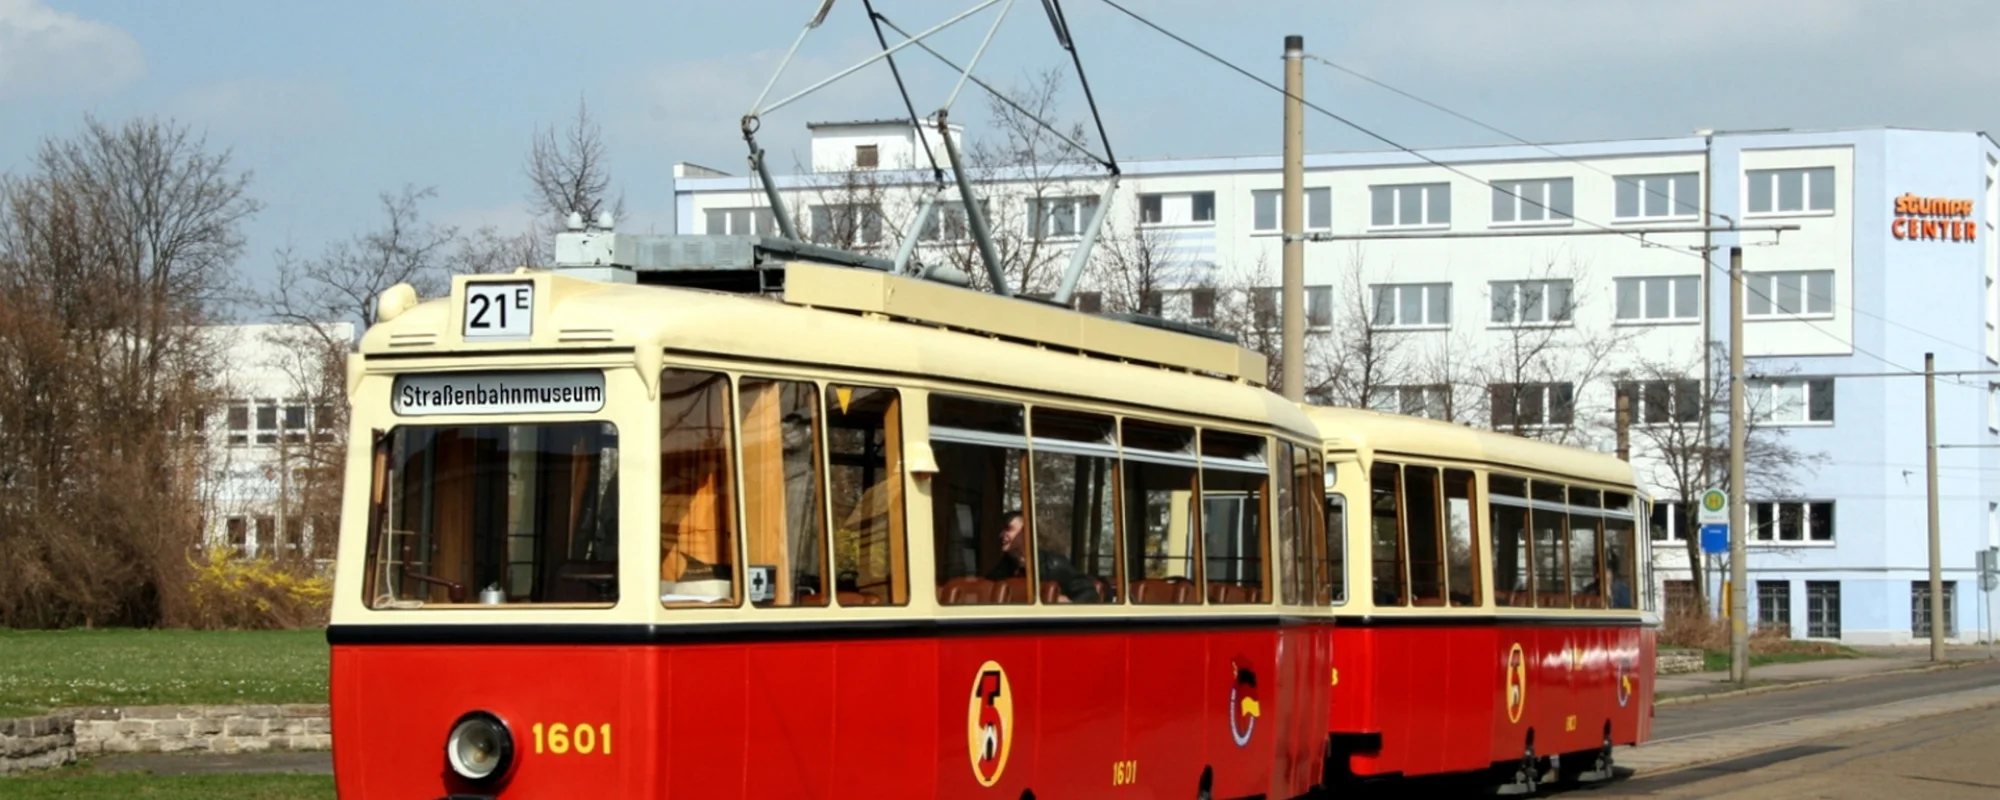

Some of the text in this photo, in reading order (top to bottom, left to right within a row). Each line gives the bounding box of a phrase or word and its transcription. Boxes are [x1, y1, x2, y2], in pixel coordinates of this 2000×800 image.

[1891, 217, 1976, 242] CENTER
[402, 383, 602, 408] Straßenbahnmuseum
[532, 722, 612, 755] 1601
[1112, 760, 1137, 786] 1601
